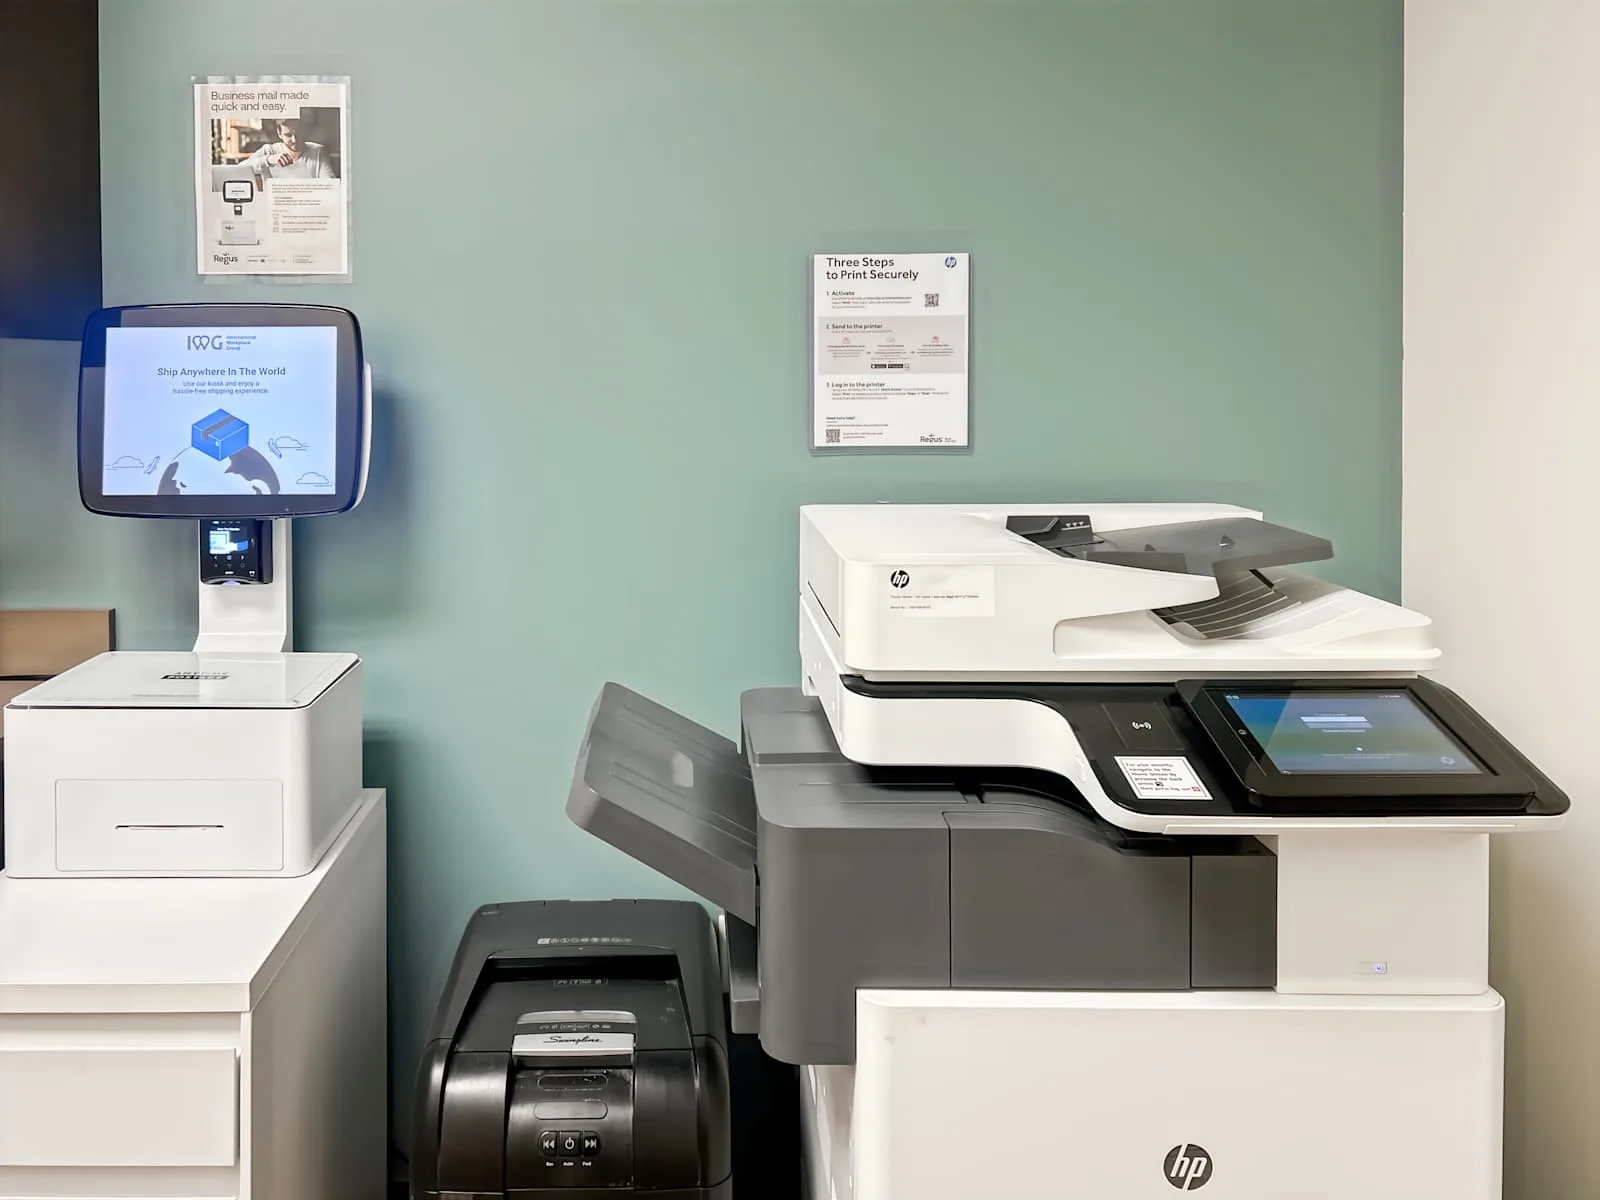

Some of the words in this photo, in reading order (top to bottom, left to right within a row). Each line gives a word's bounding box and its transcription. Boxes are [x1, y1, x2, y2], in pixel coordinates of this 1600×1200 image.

[211, 91, 255, 100] Business
[257, 91, 278, 100] mail
[280, 91, 309, 100] made
[211, 102, 238, 113] quick
[240, 102, 260, 111] and
[262, 103, 287, 112] easy.
[213, 253, 239, 266] Regus
[826, 257, 860, 267] Three
[862, 257, 895, 269] Steps
[826, 270, 838, 280] to
[840, 270, 868, 280] Print
[870, 269, 919, 281] Securely
[187, 335, 223, 351] IWG
[157, 367, 178, 377] Ship
[180, 367, 226, 378] Anywhere
[228, 367, 237, 376] In
[239, 367, 257, 376] The
[259, 367, 286, 376] World
[238, 381, 254, 389] enjoy
[890, 569, 910, 589] hp
[1163, 1143, 1213, 1191] hp
